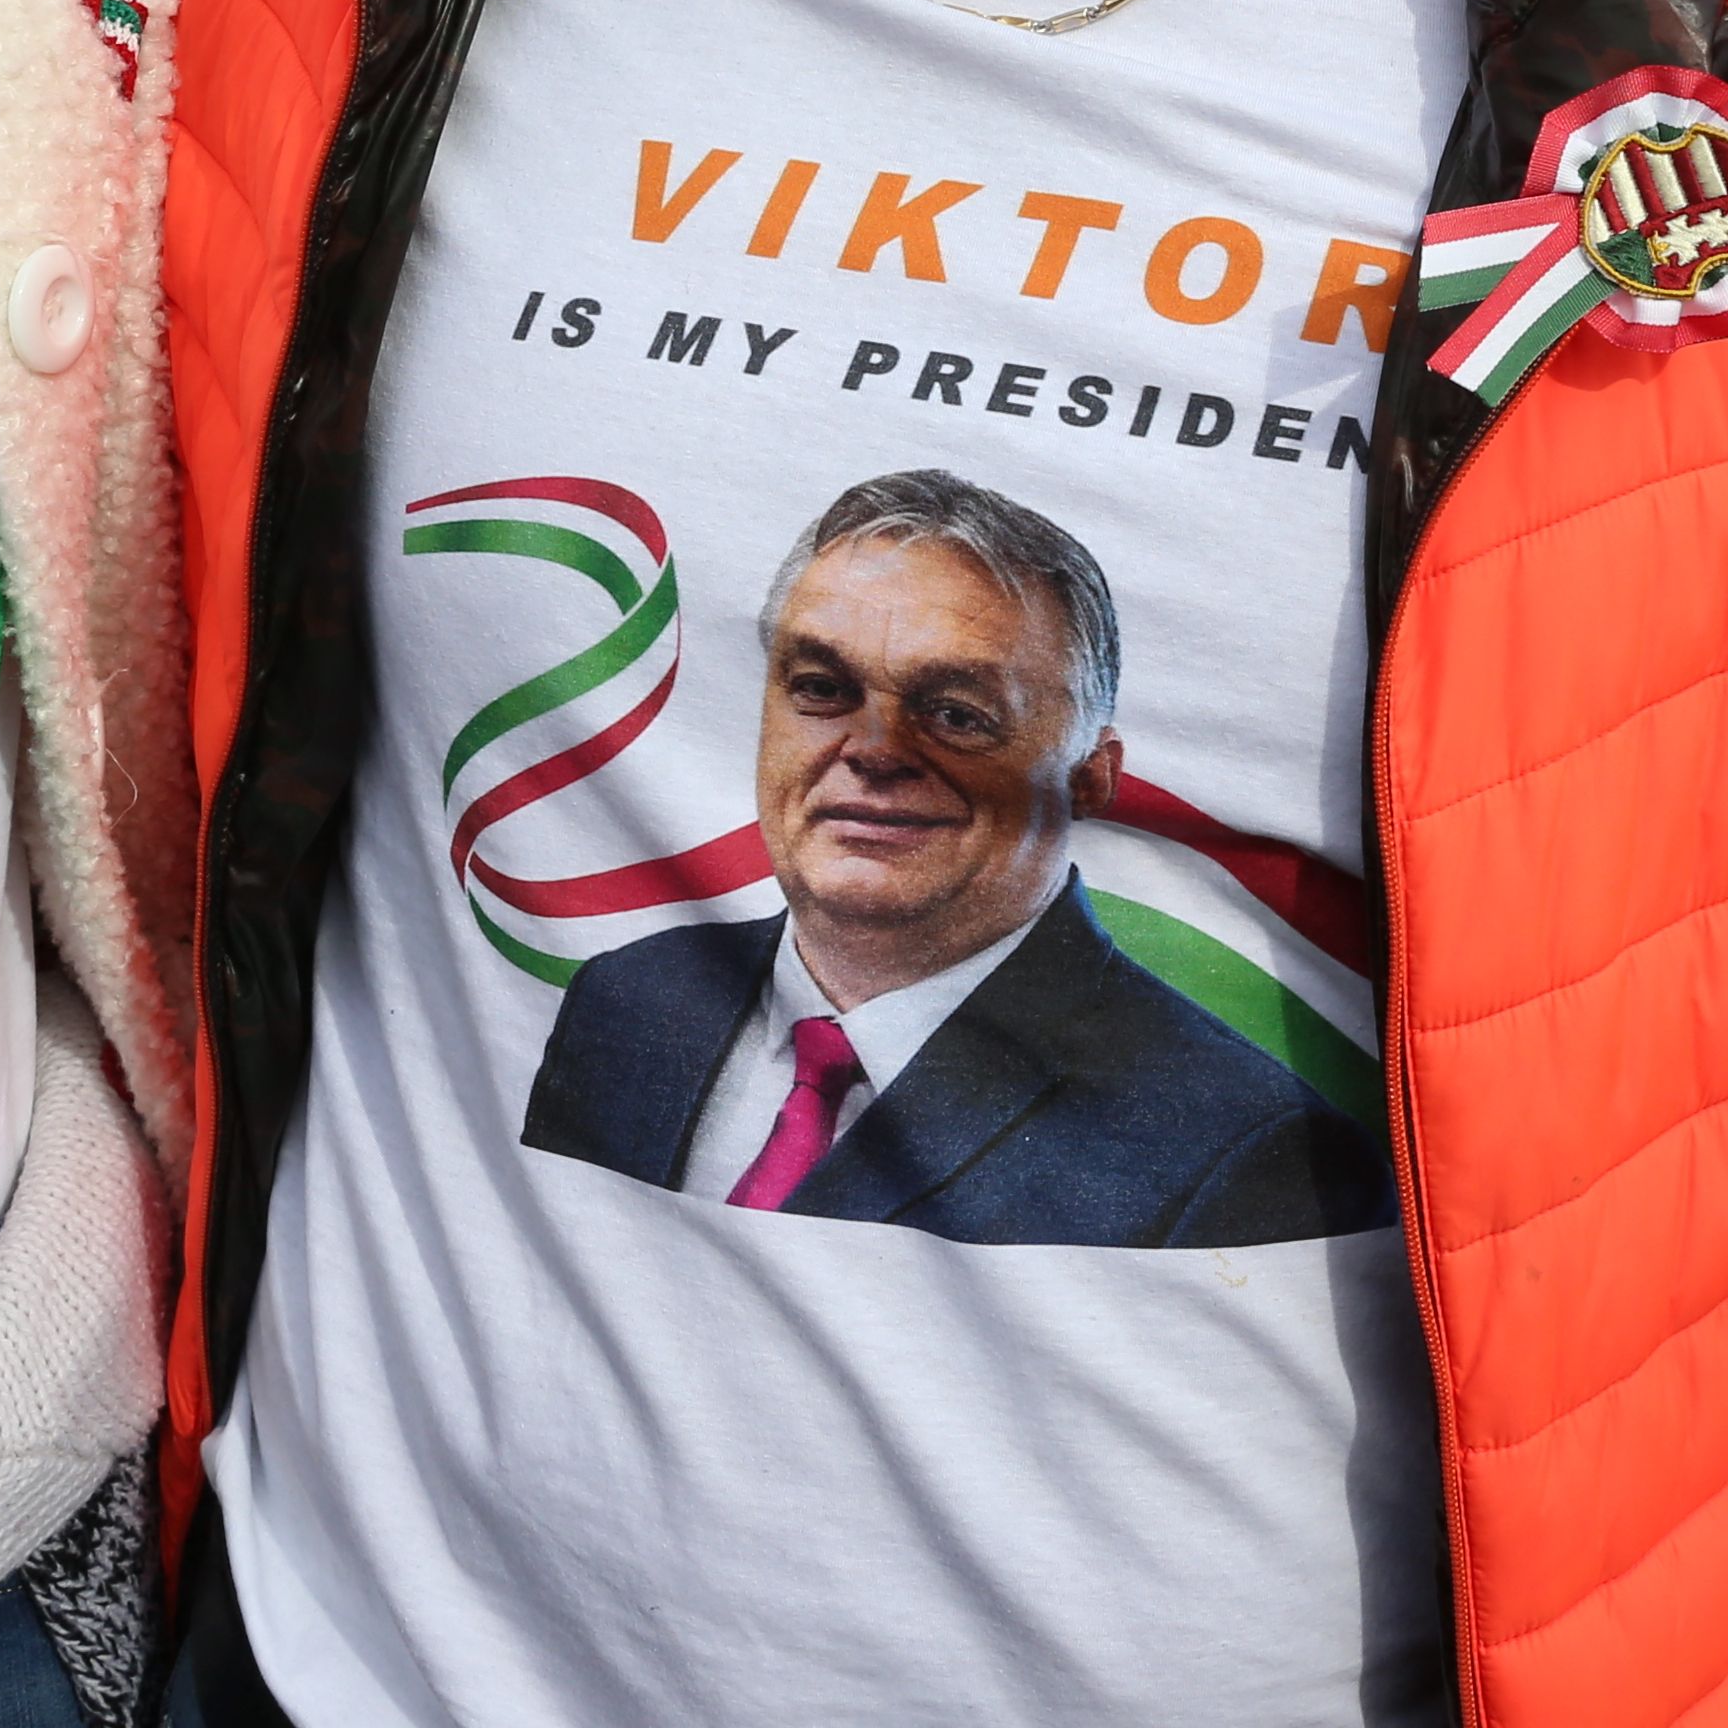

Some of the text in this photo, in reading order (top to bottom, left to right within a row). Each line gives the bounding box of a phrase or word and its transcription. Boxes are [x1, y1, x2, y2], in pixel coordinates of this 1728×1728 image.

[632, 140, 1412, 354] VIKTOR
[512, 291, 601, 349] IS
[647, 311, 797, 377] MY
